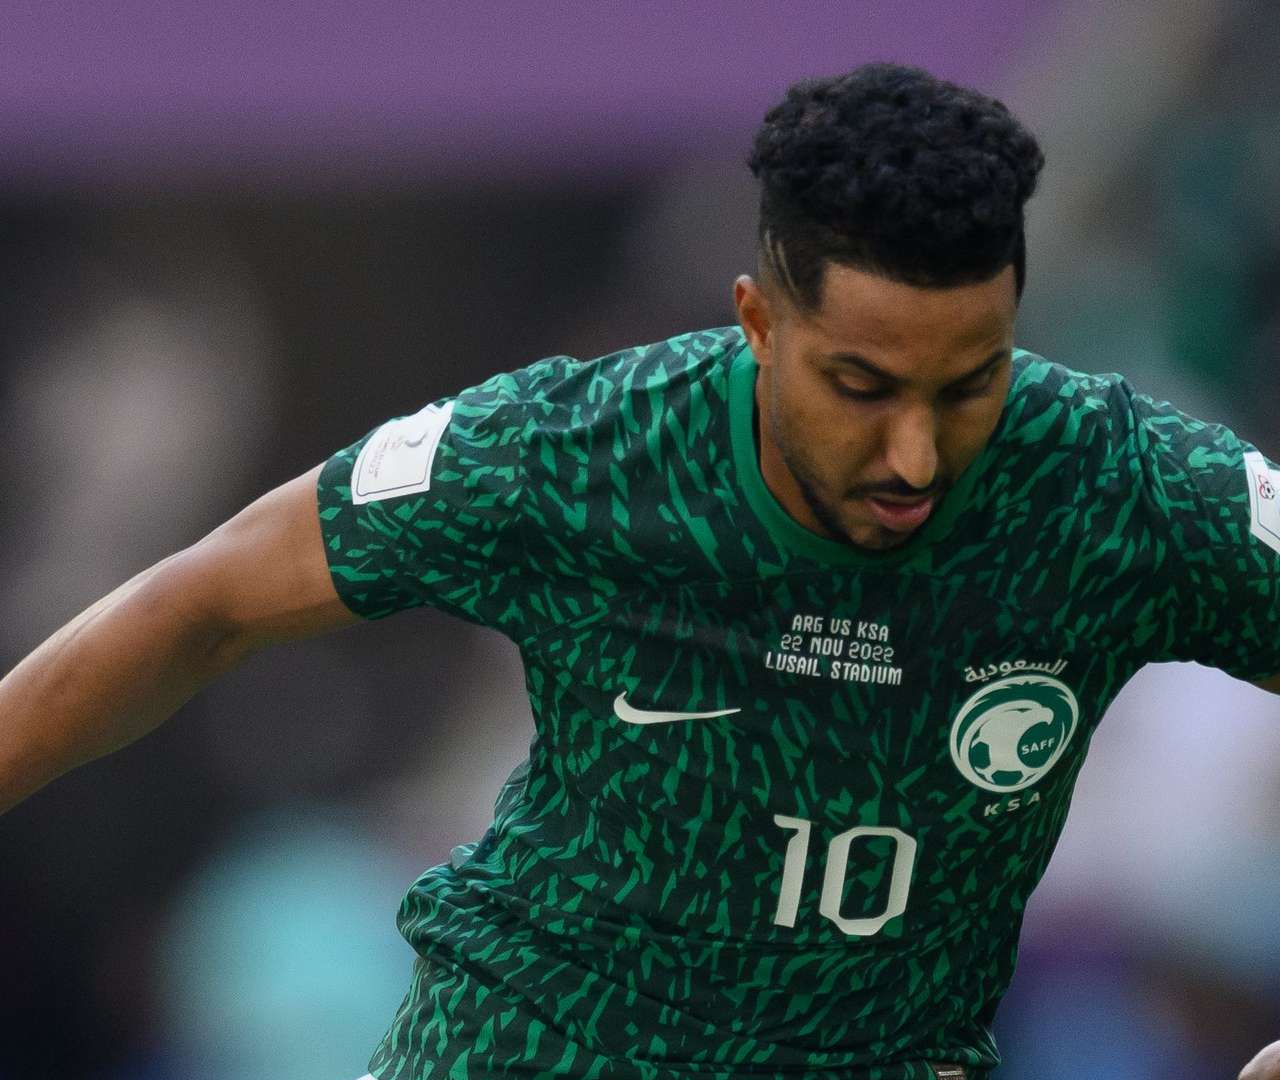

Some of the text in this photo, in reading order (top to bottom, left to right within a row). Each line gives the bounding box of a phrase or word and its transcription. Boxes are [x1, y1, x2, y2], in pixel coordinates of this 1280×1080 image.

[792, 614, 824, 633] ARG
[857, 620, 889, 642] KSA
[781, 634, 895, 663] 22 NOV 2022
[765, 651, 903, 686] LUSAIL STADIUM
[964, 658, 1068, 683] السعودية
[1022, 738, 1055, 756] SAFF
[773, 813, 917, 937] 10
